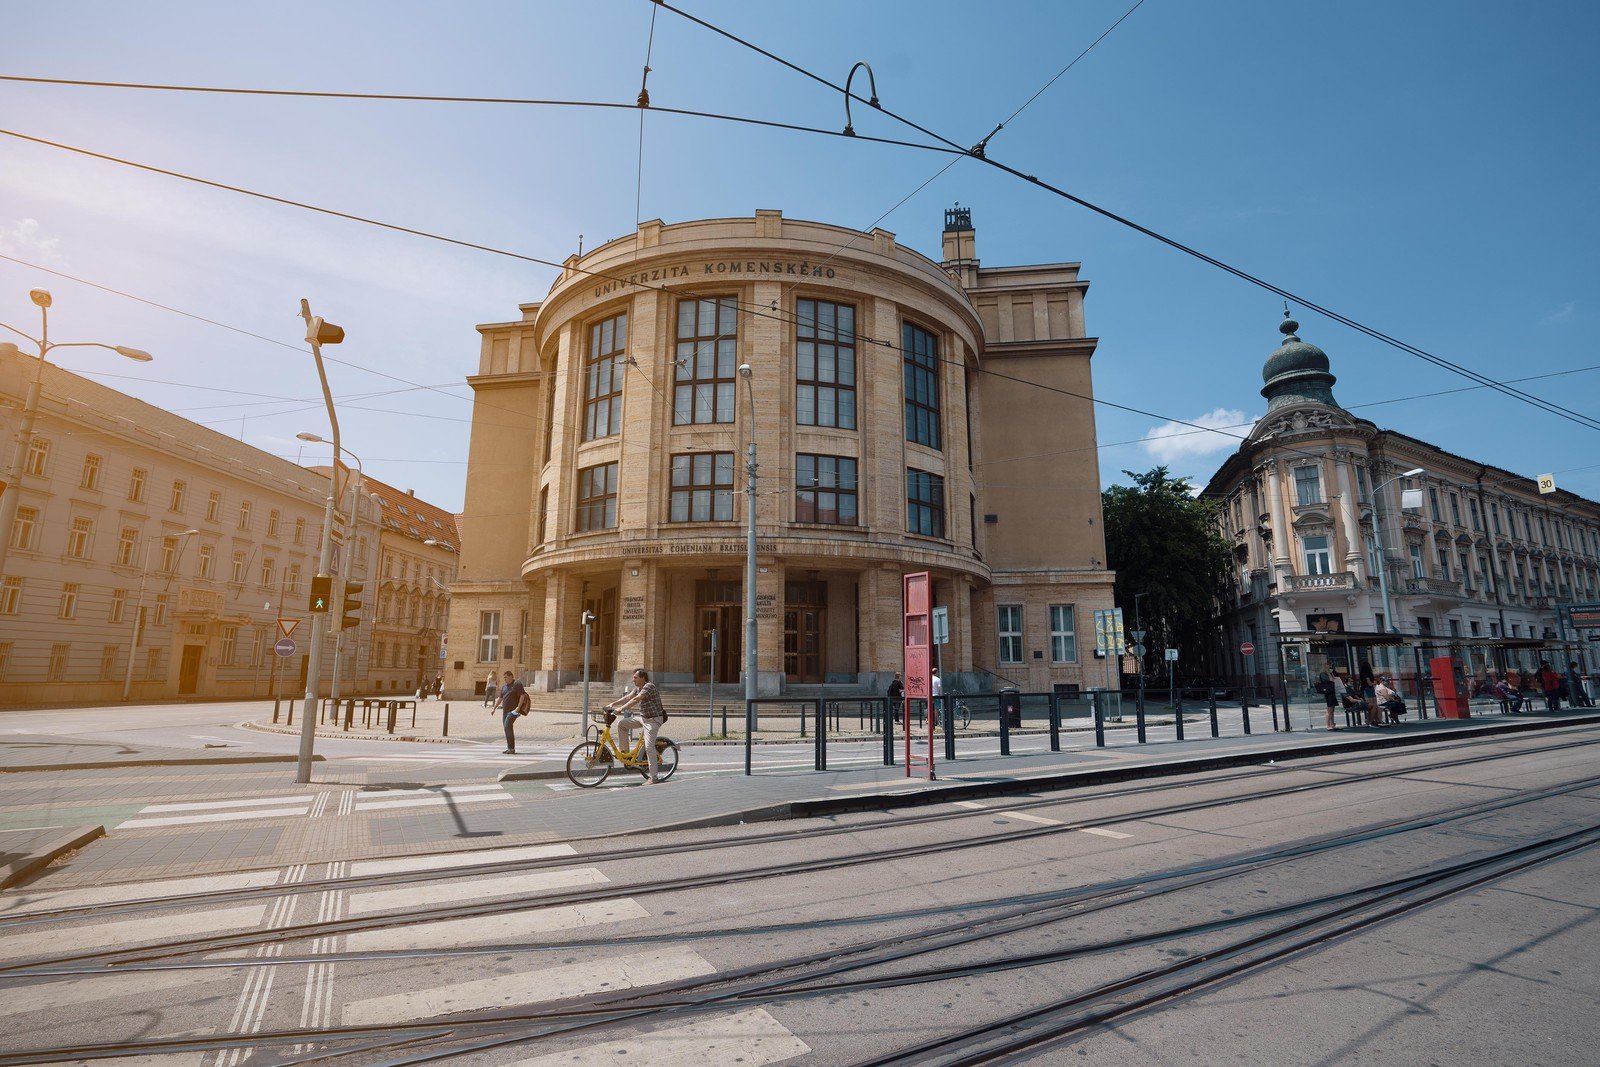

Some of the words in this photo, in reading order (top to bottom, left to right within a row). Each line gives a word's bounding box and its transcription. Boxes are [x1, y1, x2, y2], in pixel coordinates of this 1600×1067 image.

[595, 264, 690, 298] UNIVERZITA
[704, 260, 836, 279] KOMENSKÉHO
[1541, 480, 1552, 489] 30
[622, 545, 664, 555] UNIVERSITAS
[670, 544, 713, 553] COMENIANA
[720, 544, 777, 552] BRATISLENSIS
